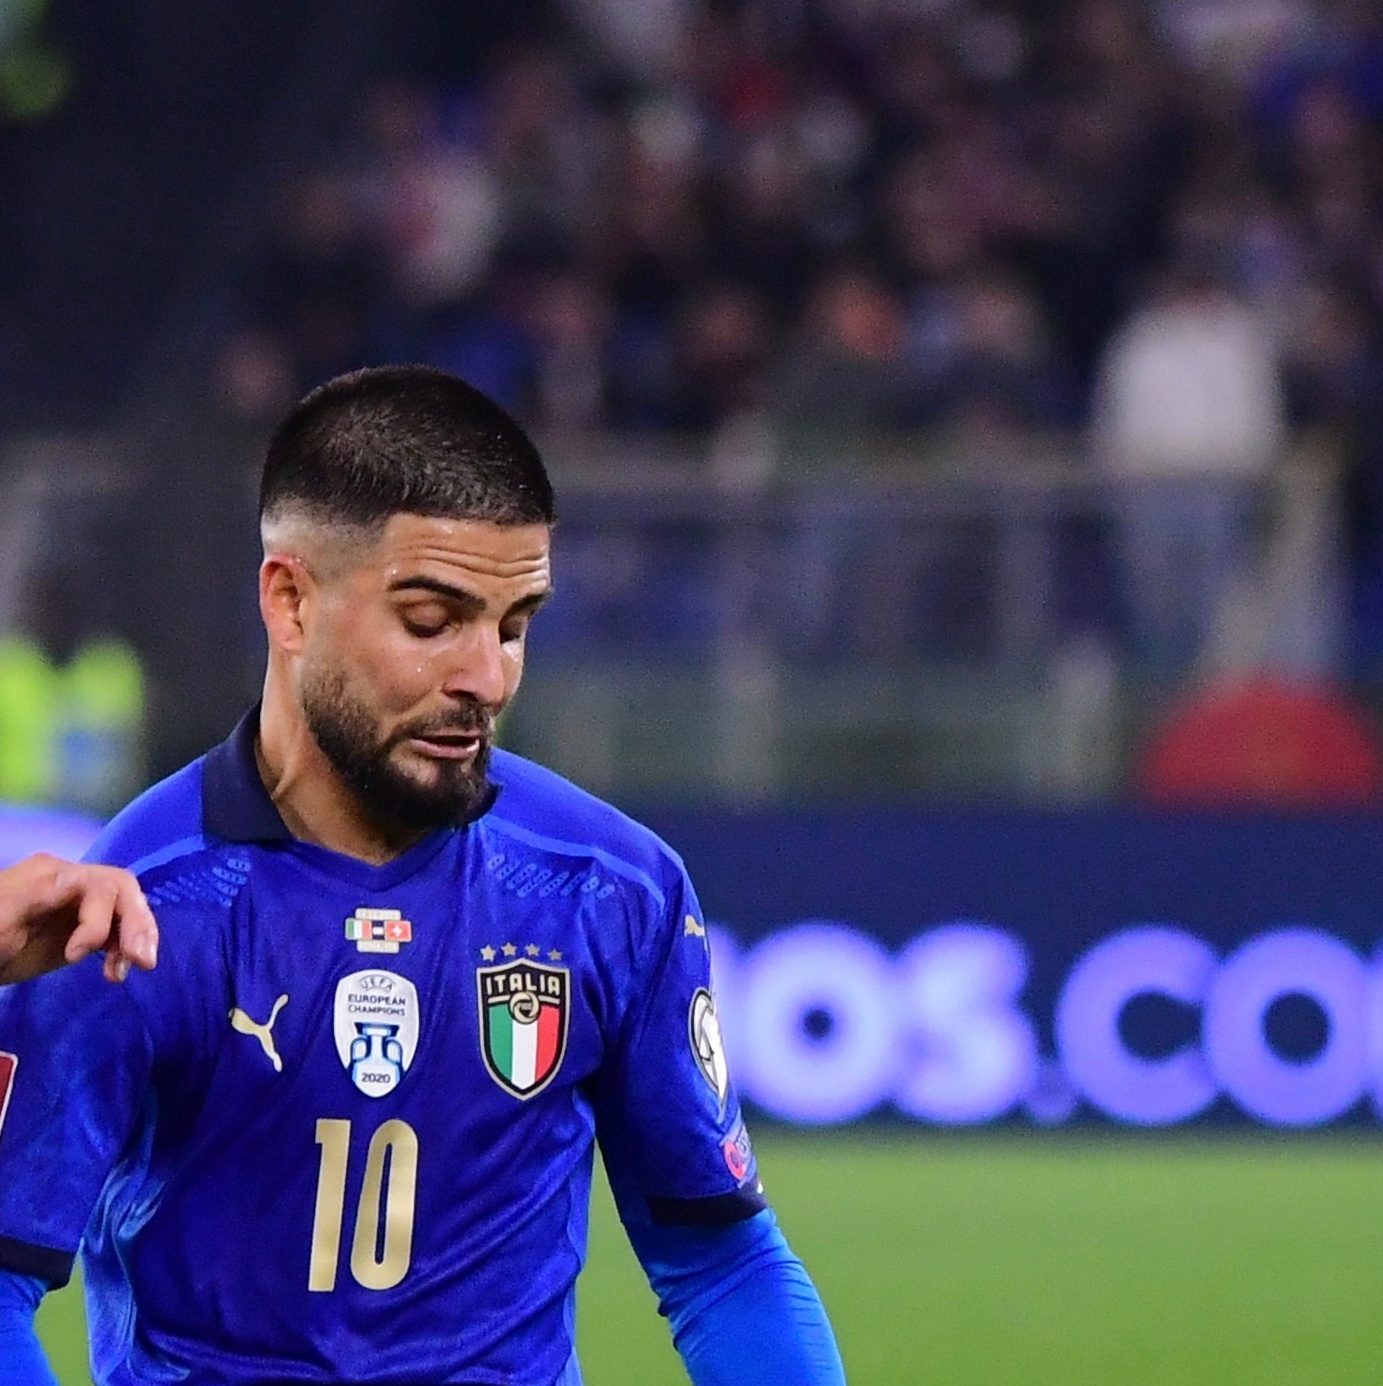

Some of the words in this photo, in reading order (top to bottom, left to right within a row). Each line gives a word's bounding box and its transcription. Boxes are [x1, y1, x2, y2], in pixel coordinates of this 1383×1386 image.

[359, 976, 394, 994] UEFA
[486, 972, 560, 996] ITALIA
[348, 994, 406, 1006] EUROPEAN
[347, 1004, 406, 1017] CHAMPIONS
[710, 918, 1383, 1126] os.co
[361, 1072, 391, 1084] 2020
[307, 1118, 419, 1291] 10
